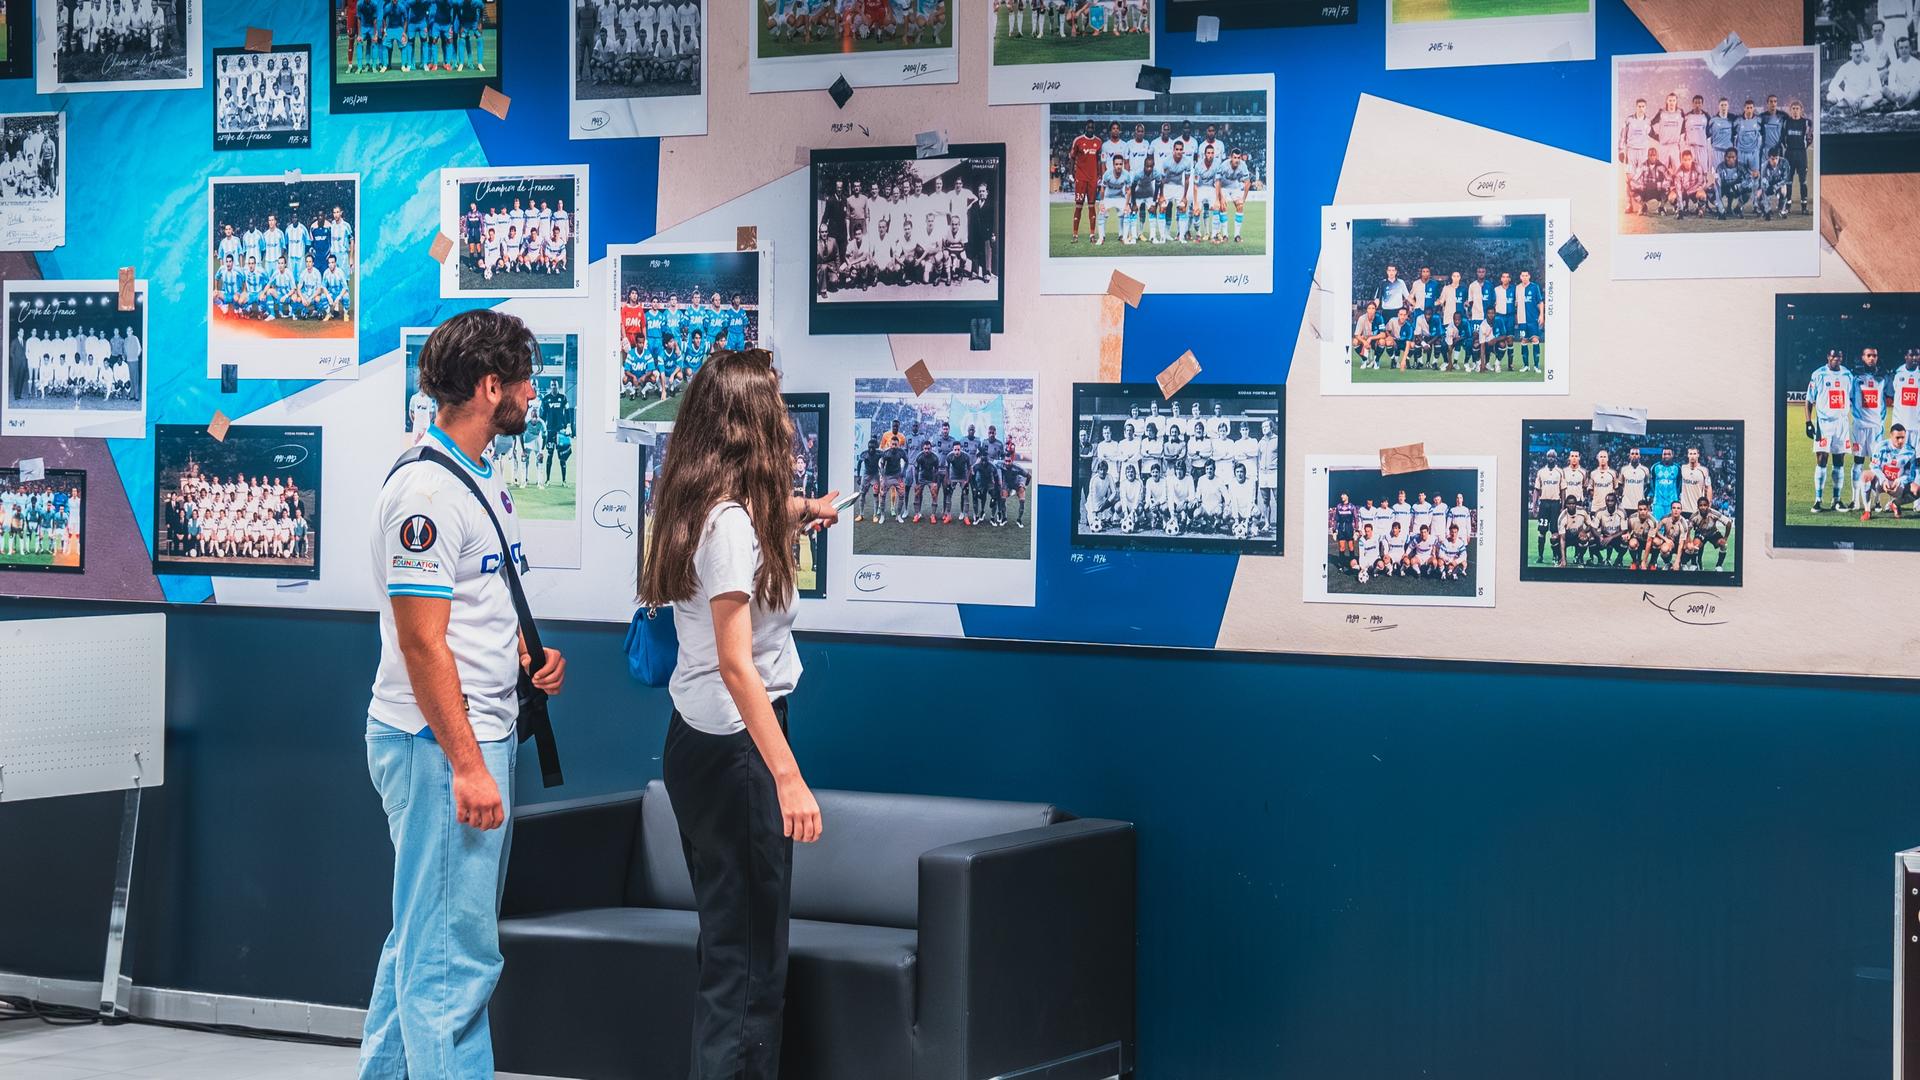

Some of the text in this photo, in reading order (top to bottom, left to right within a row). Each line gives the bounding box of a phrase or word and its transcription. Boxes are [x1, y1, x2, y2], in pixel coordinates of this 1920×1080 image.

[476, 178, 556, 201] Champion de France
[1477, 180, 1506, 192] 2004/05
[1548, 369, 1553, 380] 50
[1903, 391, 1918, 401] SFR
[1539, 518, 1548, 526] 23
[392, 560, 439, 569] FOUNDATION
[1687, 604, 1715, 616] 2009/10
